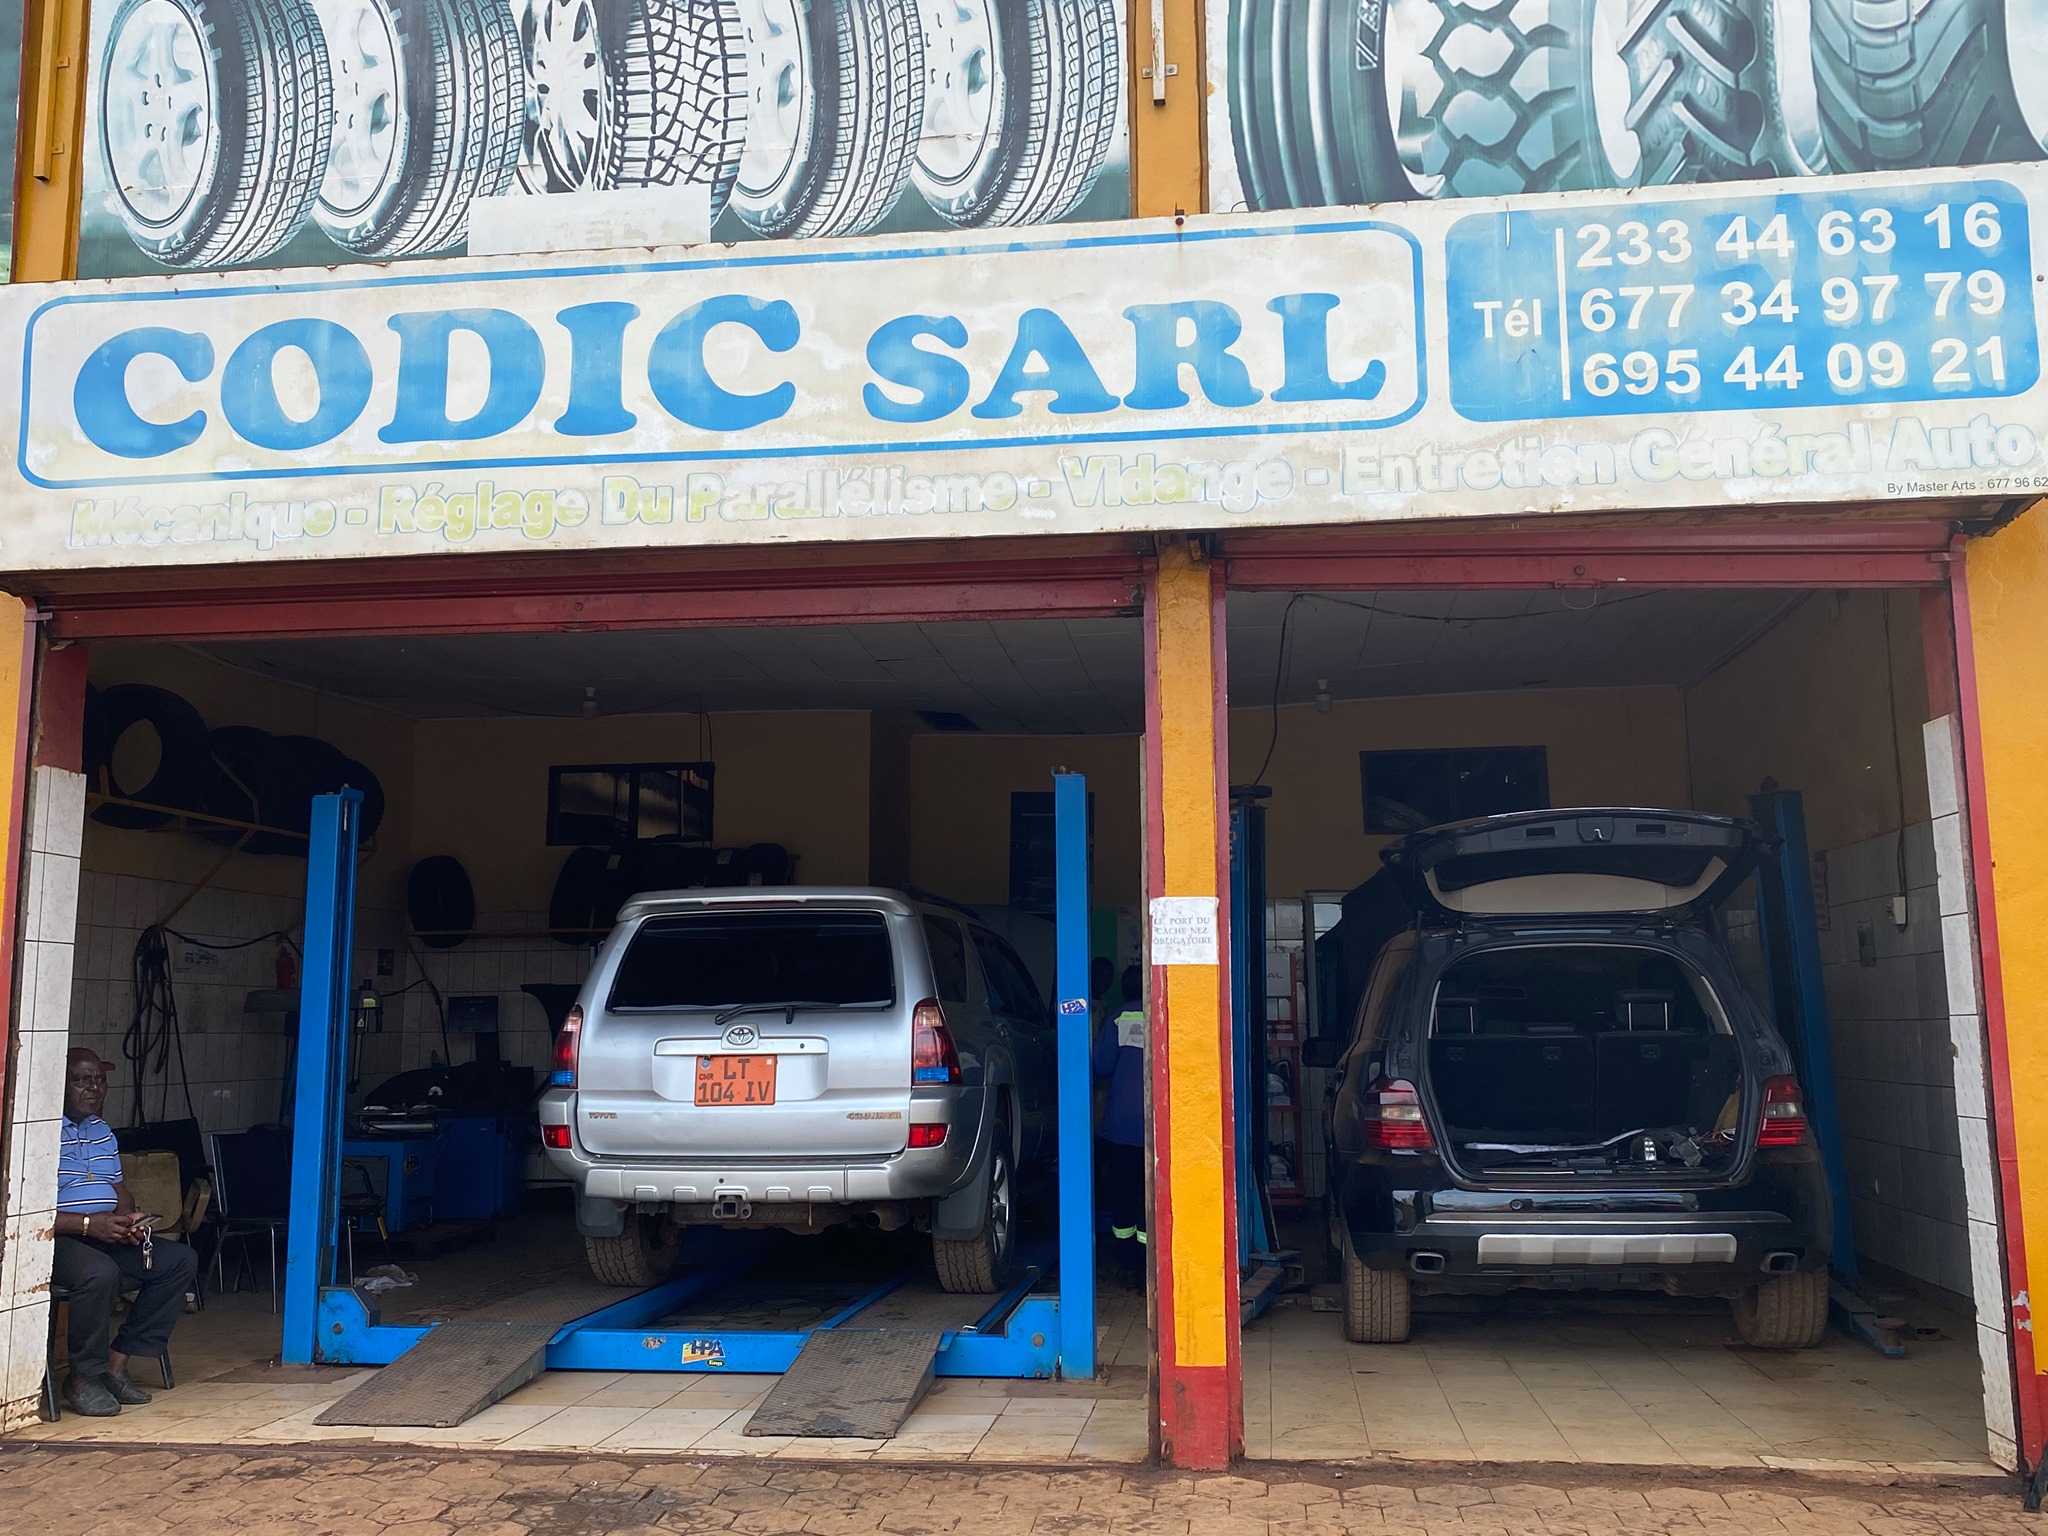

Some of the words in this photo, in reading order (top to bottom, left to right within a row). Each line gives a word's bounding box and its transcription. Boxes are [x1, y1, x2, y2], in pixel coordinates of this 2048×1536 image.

[1577, 219, 1692, 268] 233
[1716, 214, 1795, 259] 44
[1818, 208, 1896, 256] 63
[1924, 202, 2002, 249] 16
[1579, 285, 1696, 332] 677
[1720, 279, 1799, 326] 34
[1821, 274, 1900, 322] 97
[1924, 269, 2005, 317] 79
[1473, 299, 1542, 340] Tél
[73, 294, 800, 459] CODIC
[862, 292, 1387, 423] SARL
[1583, 349, 1701, 398] 695
[1724, 344, 1803, 391] 44
[1826, 341, 1906, 388] 09
[1931, 335, 2005, 383] 21
[378, 480, 589, 542] Réglage
[602, 476, 673, 525] Du
[1061, 453, 1294, 513] Vidange
[1342, 434, 1616, 495] Entretien
[1630, 422, 1872, 480] Général
[1886, 413, 2037, 471] Auto
[1887, 482, 1902, 495] By
[1907, 481, 1948, 492] Master
[1951, 480, 1975, 491] Arts
[1987, 478, 2010, 489] 677
[2014, 477, 2030, 488] 96
[2033, 476, 2048, 487] 62
[1156, 927, 1187, 935] CACHE
[1191, 927, 1208, 935] NEZ
[1170, 917, 1192, 925] PORT
[1197, 917, 1210, 925] DU
[1153, 937, 1212, 946] OBLIGATOIRE
[1061, 1000, 1084, 1014] HPA
[724, 1059, 750, 1079] LT
[698, 1082, 734, 1103] 104
[745, 1081, 770, 1102] IV
[690, 1339, 725, 1356] HPA
